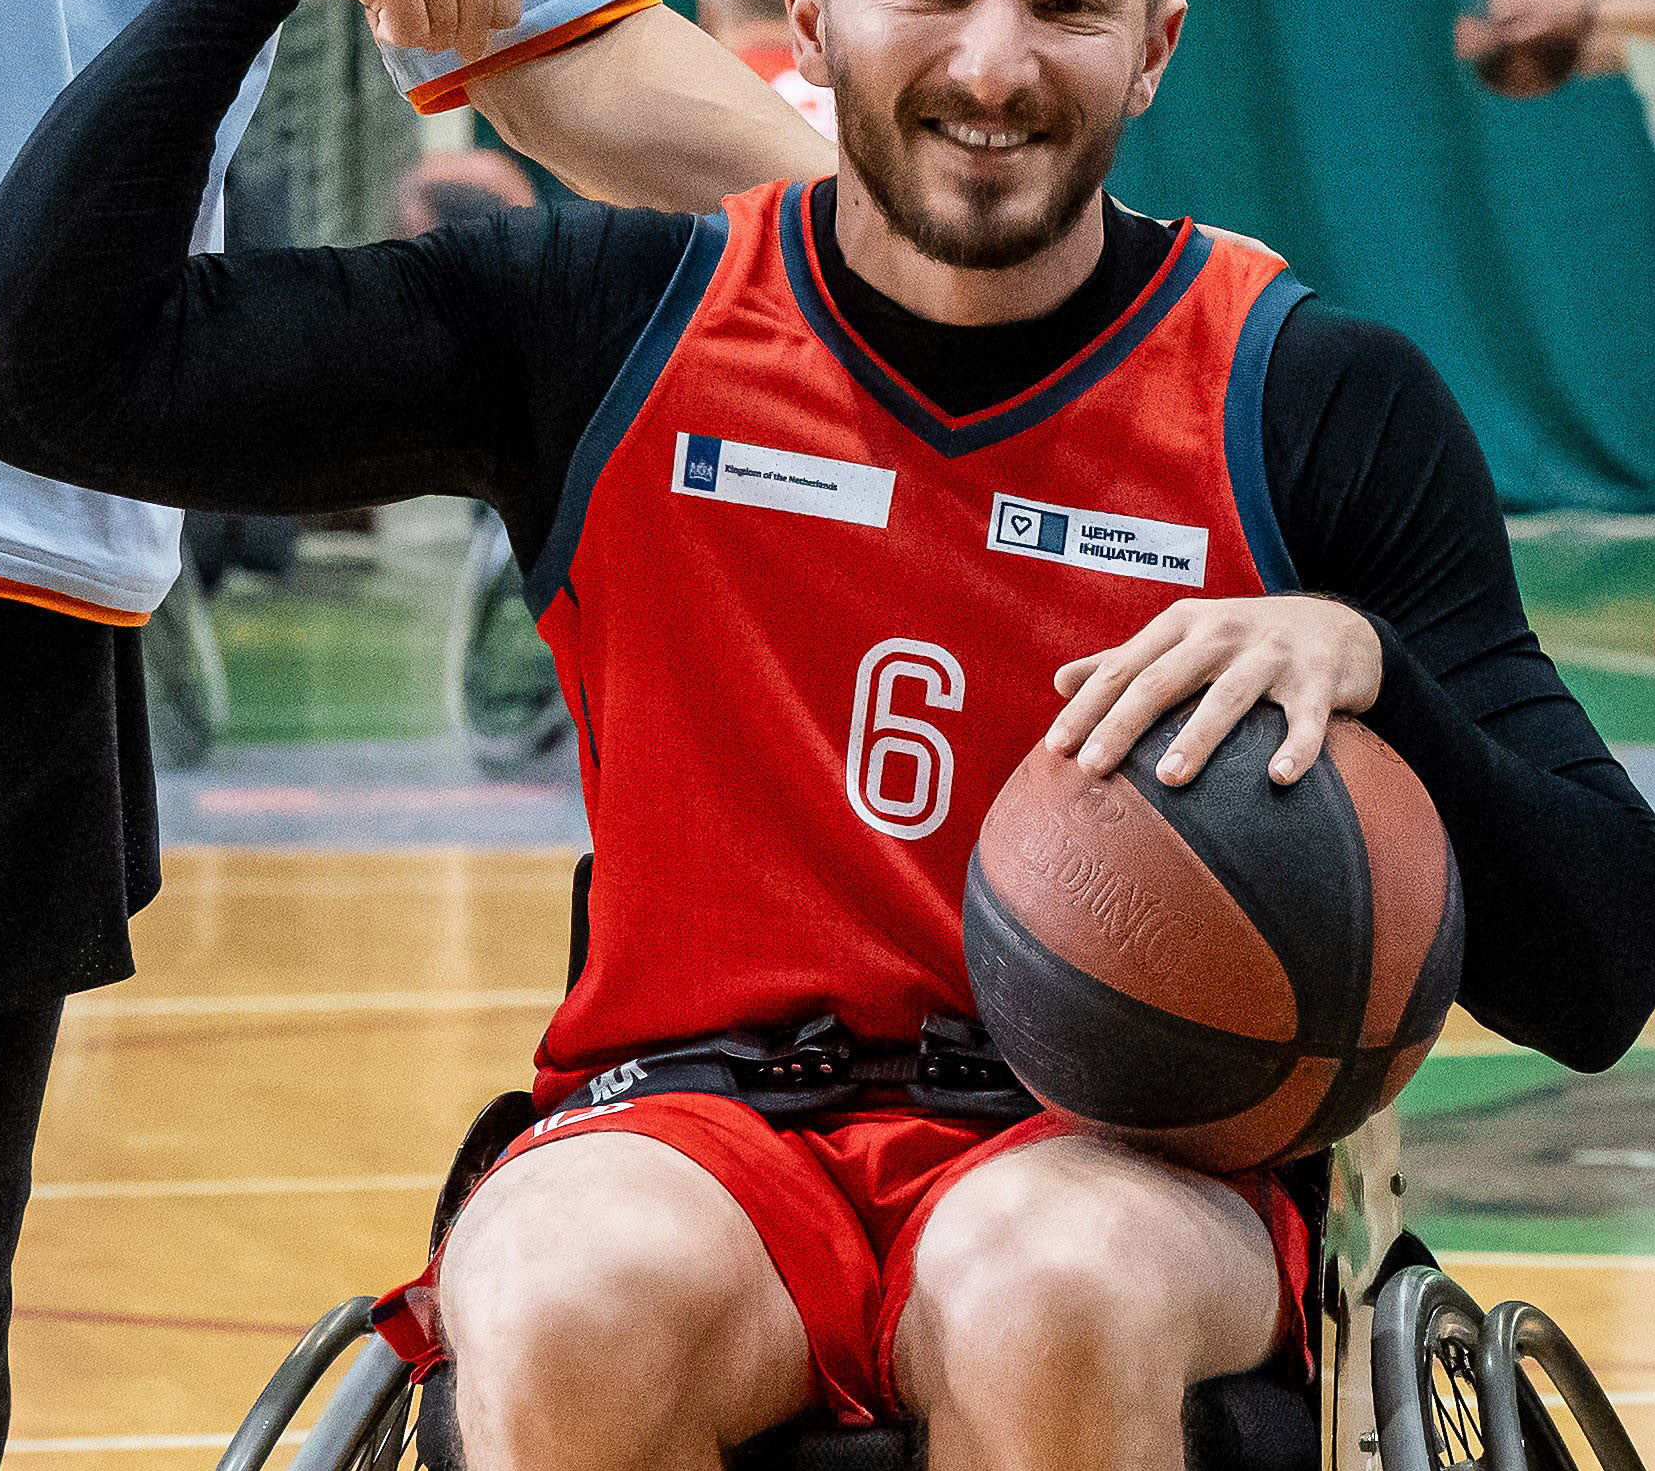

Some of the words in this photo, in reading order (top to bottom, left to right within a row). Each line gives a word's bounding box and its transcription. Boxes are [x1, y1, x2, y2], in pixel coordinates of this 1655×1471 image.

[725, 464, 761, 478] Kingdom
[763, 471, 772, 480] of
[773, 473, 787, 483] the
[789, 475, 838, 491] Netherlands
[1081, 525, 1136, 544] ЦЕНТР
[1079, 543, 1159, 566] ІНІЦІАТИВ
[846, 637, 966, 841] 6
